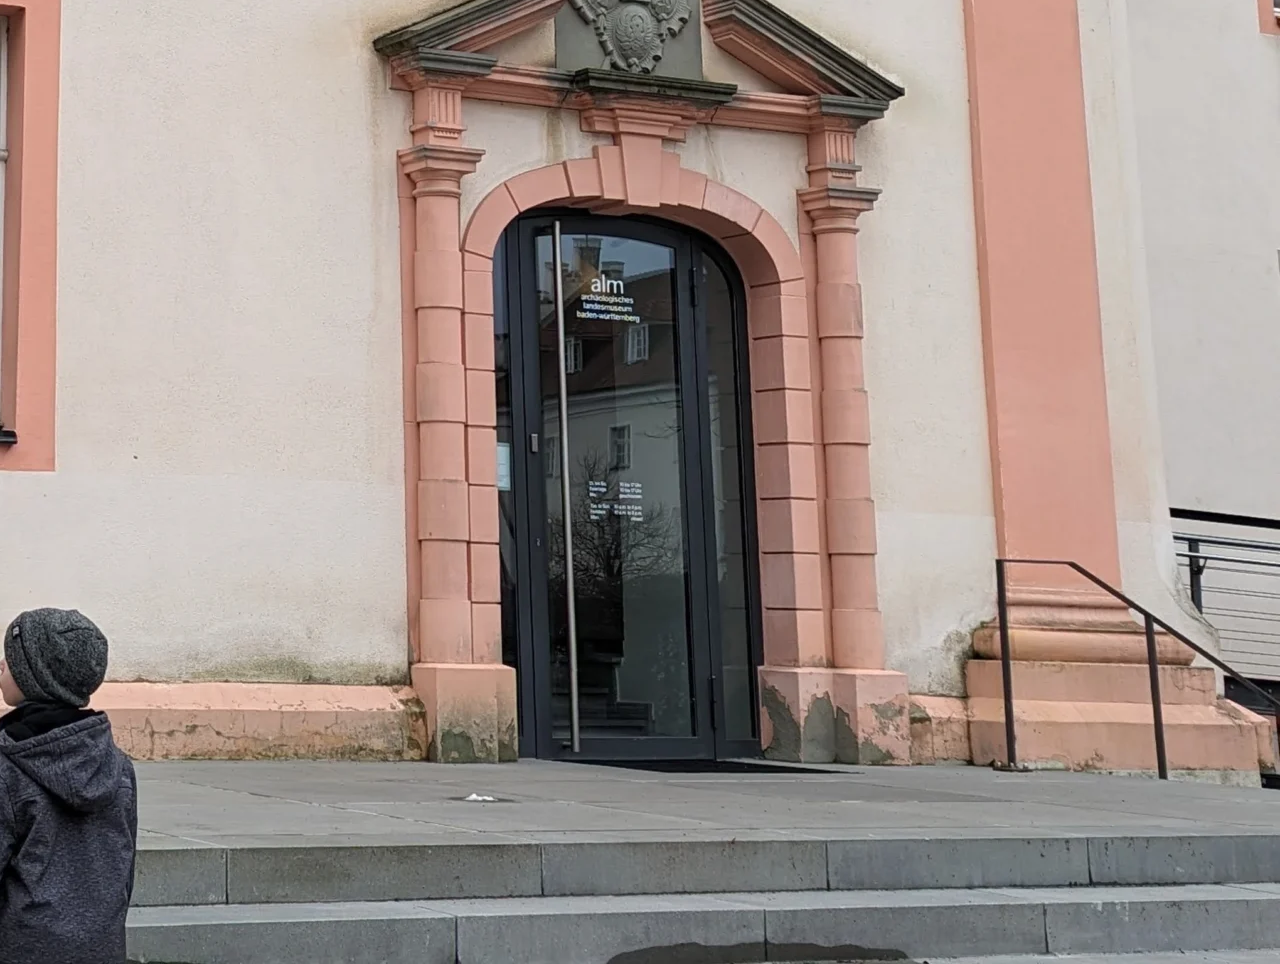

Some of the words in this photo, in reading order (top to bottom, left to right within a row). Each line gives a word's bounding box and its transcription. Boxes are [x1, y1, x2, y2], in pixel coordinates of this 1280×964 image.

[591, 274, 624, 294] alm
[583, 302, 632, 312] landesmuseum
[576, 310, 640, 323] baden-württemberg
